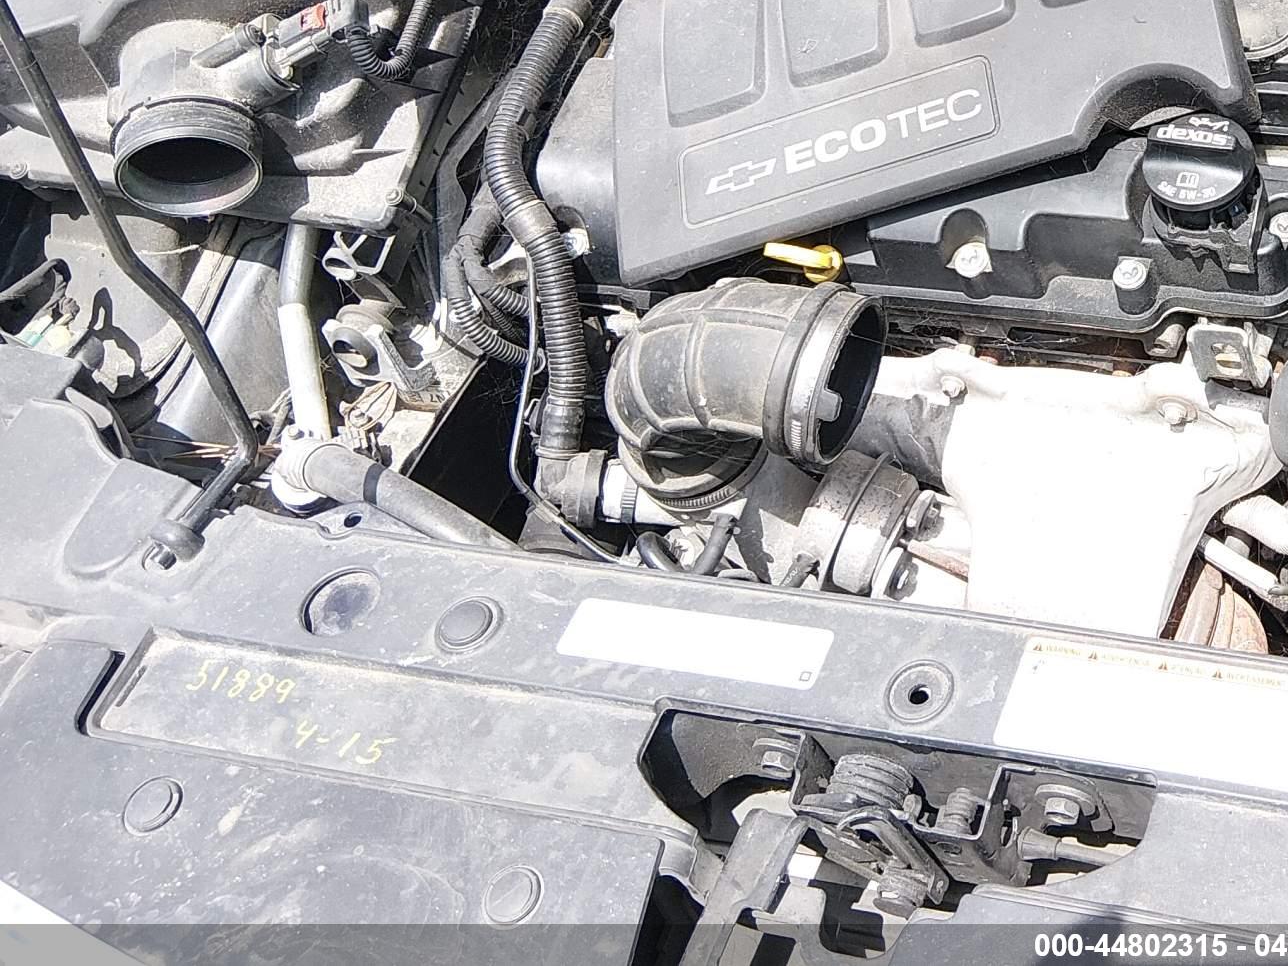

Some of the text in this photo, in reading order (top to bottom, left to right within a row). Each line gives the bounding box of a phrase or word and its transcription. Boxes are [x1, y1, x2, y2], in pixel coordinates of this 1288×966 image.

[783, 88, 983, 175] ECOTEC
[1156, 123, 1228, 147] dexos
[1157, 180, 1178, 198] SAE
[295, 719, 401, 765] 4-15
